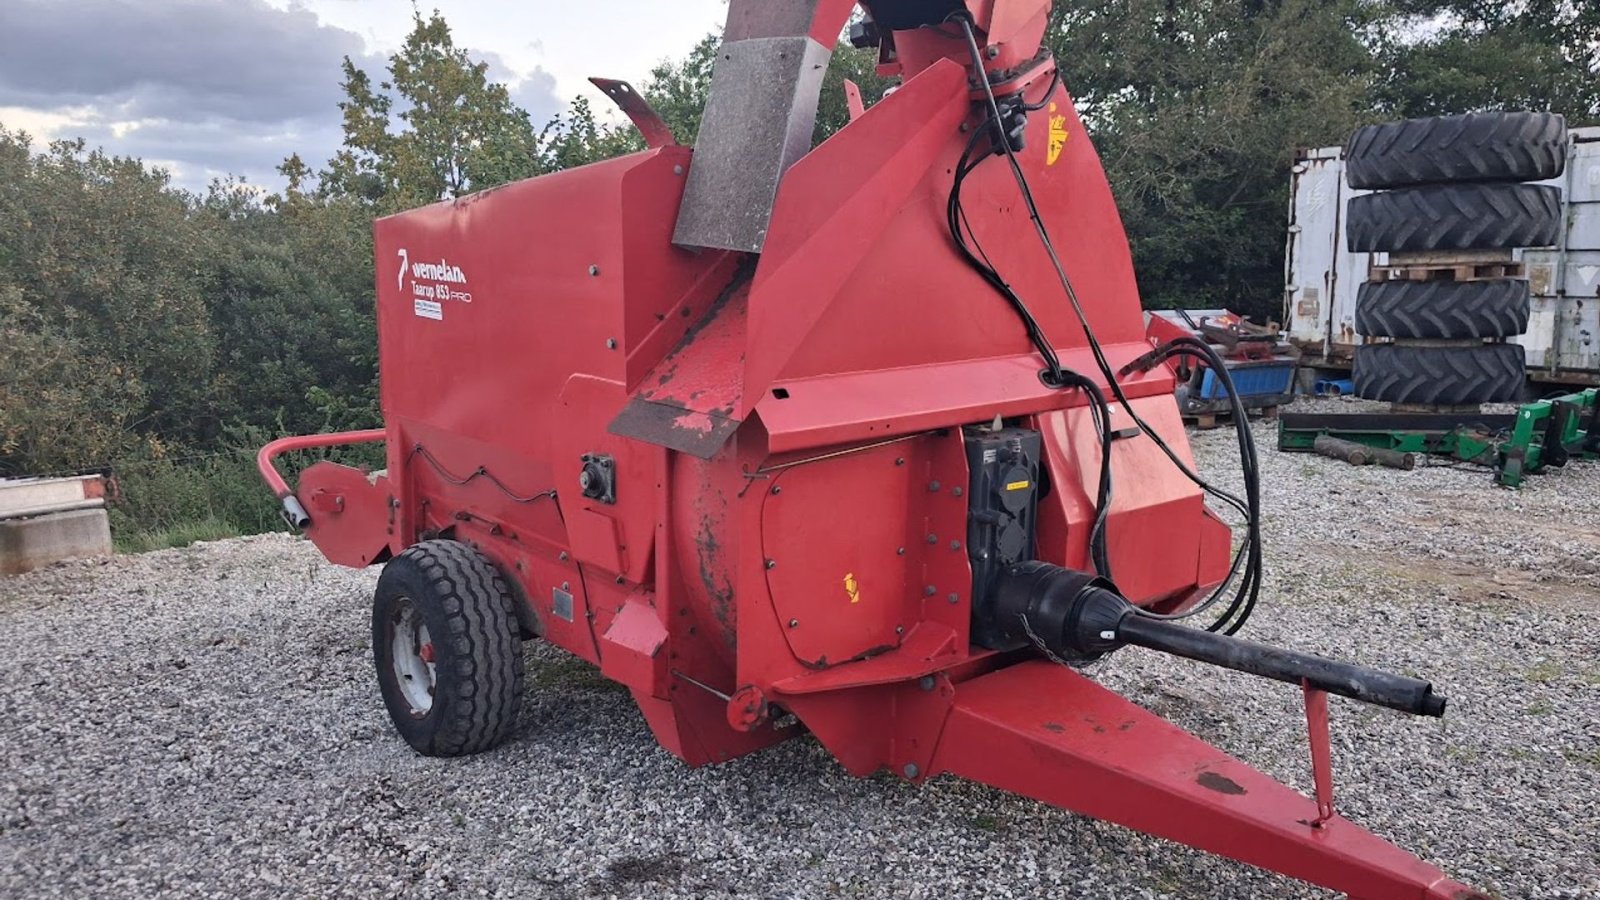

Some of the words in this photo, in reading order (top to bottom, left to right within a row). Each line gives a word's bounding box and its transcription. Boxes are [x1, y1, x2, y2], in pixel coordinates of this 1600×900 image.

[411, 281, 434, 300] Taarup
[436, 284, 449, 300] 853
[451, 292, 471, 302] PRO
